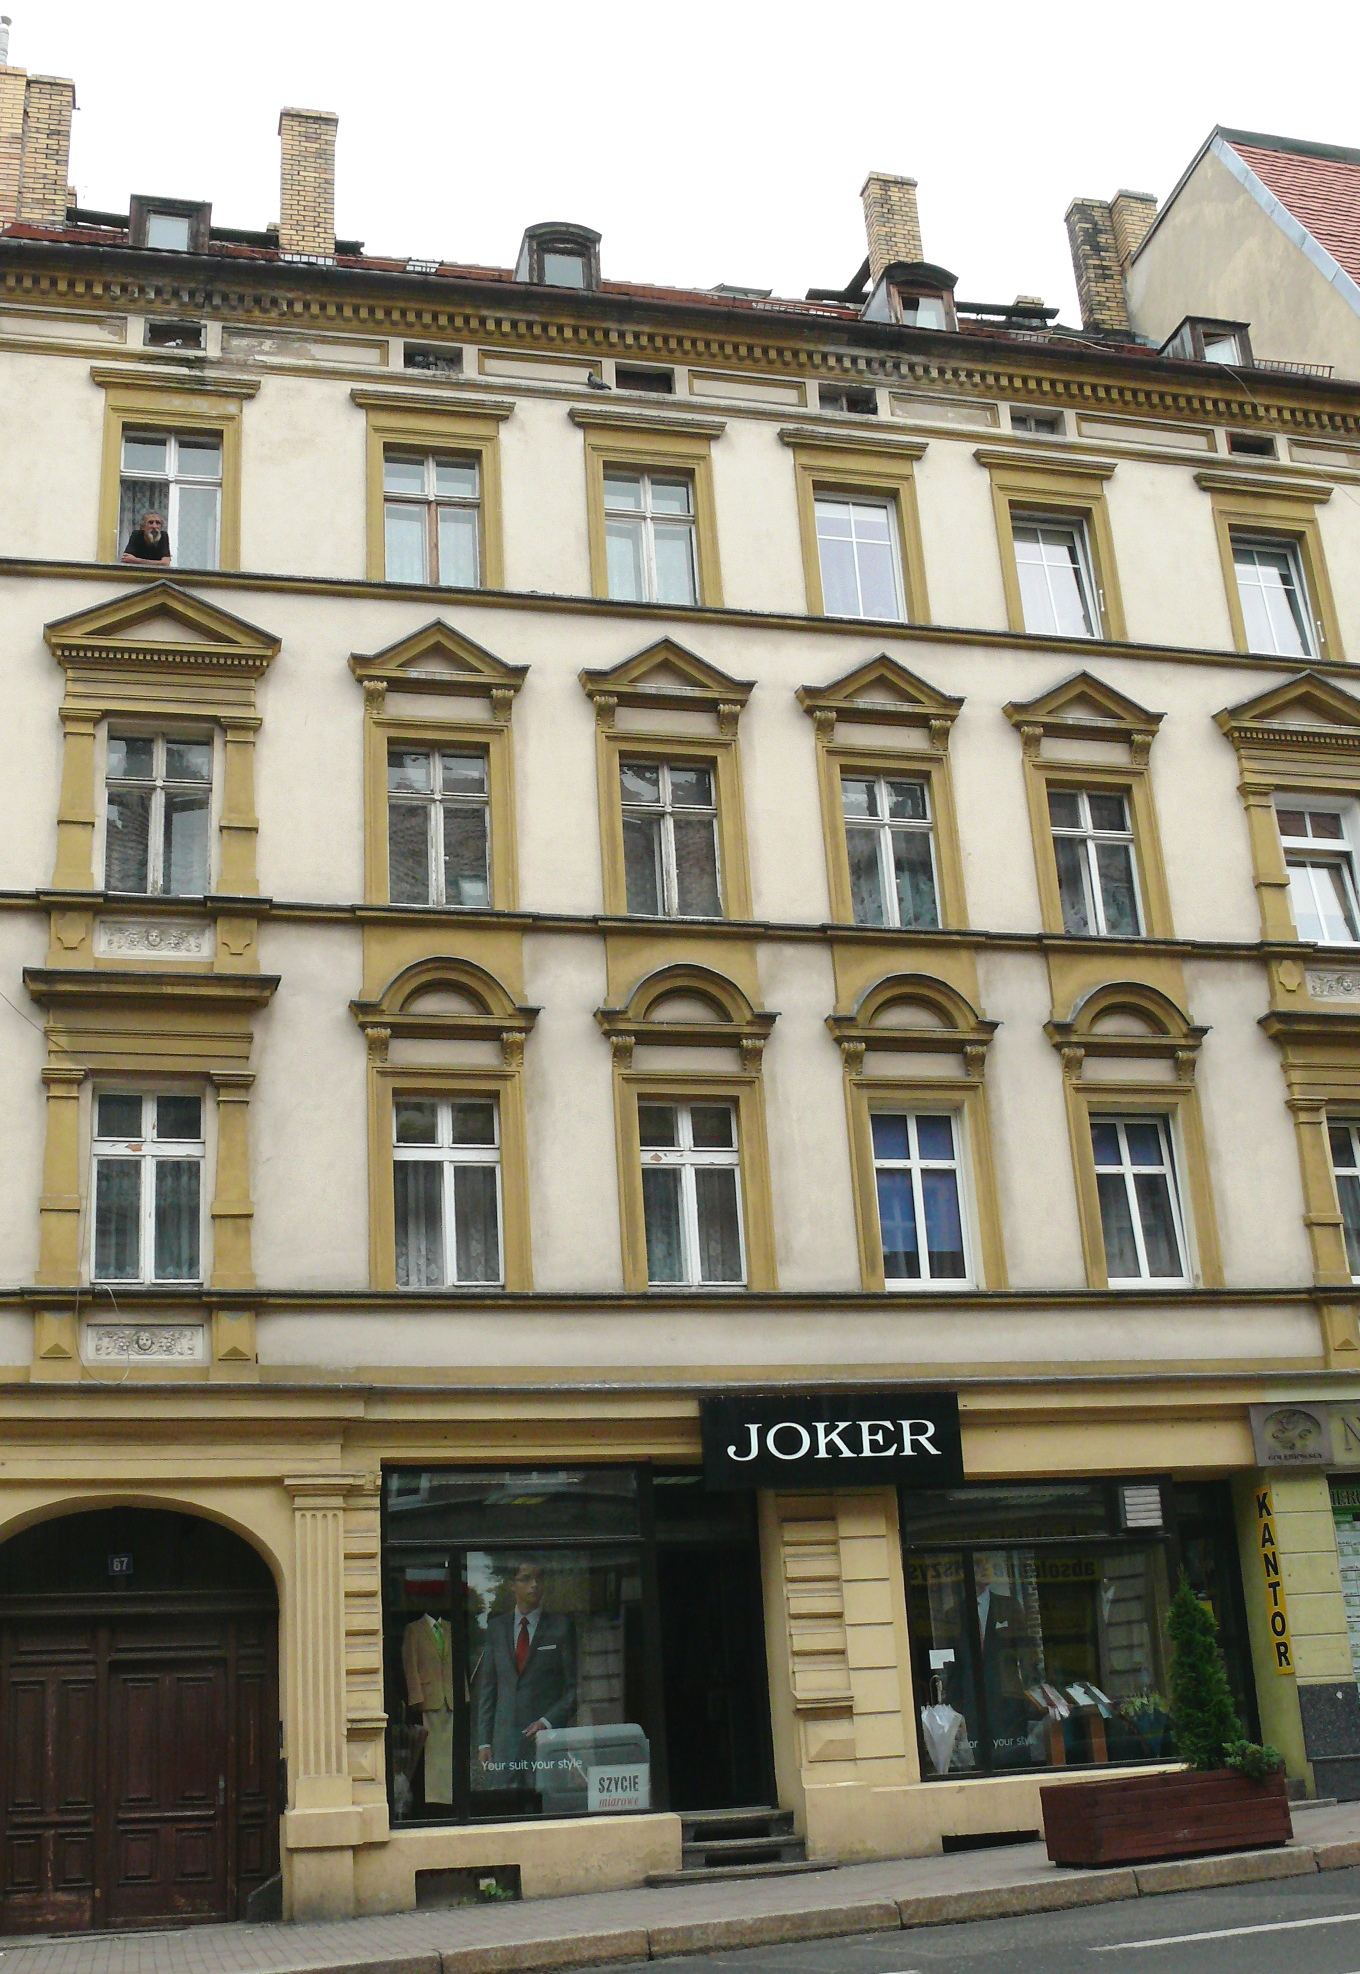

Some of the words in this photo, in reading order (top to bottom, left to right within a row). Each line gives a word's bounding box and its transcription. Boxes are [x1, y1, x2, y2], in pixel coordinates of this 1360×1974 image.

[727, 1419, 942, 1462] JOKER
[1256, 1491, 1291, 1668] KANTOR
[481, 1760, 506, 1771] Your
[508, 1760, 528, 1770] suit
[530, 1760, 554, 1772] your
[557, 1758, 583, 1771] style
[598, 1775, 639, 1793] SZYCIE
